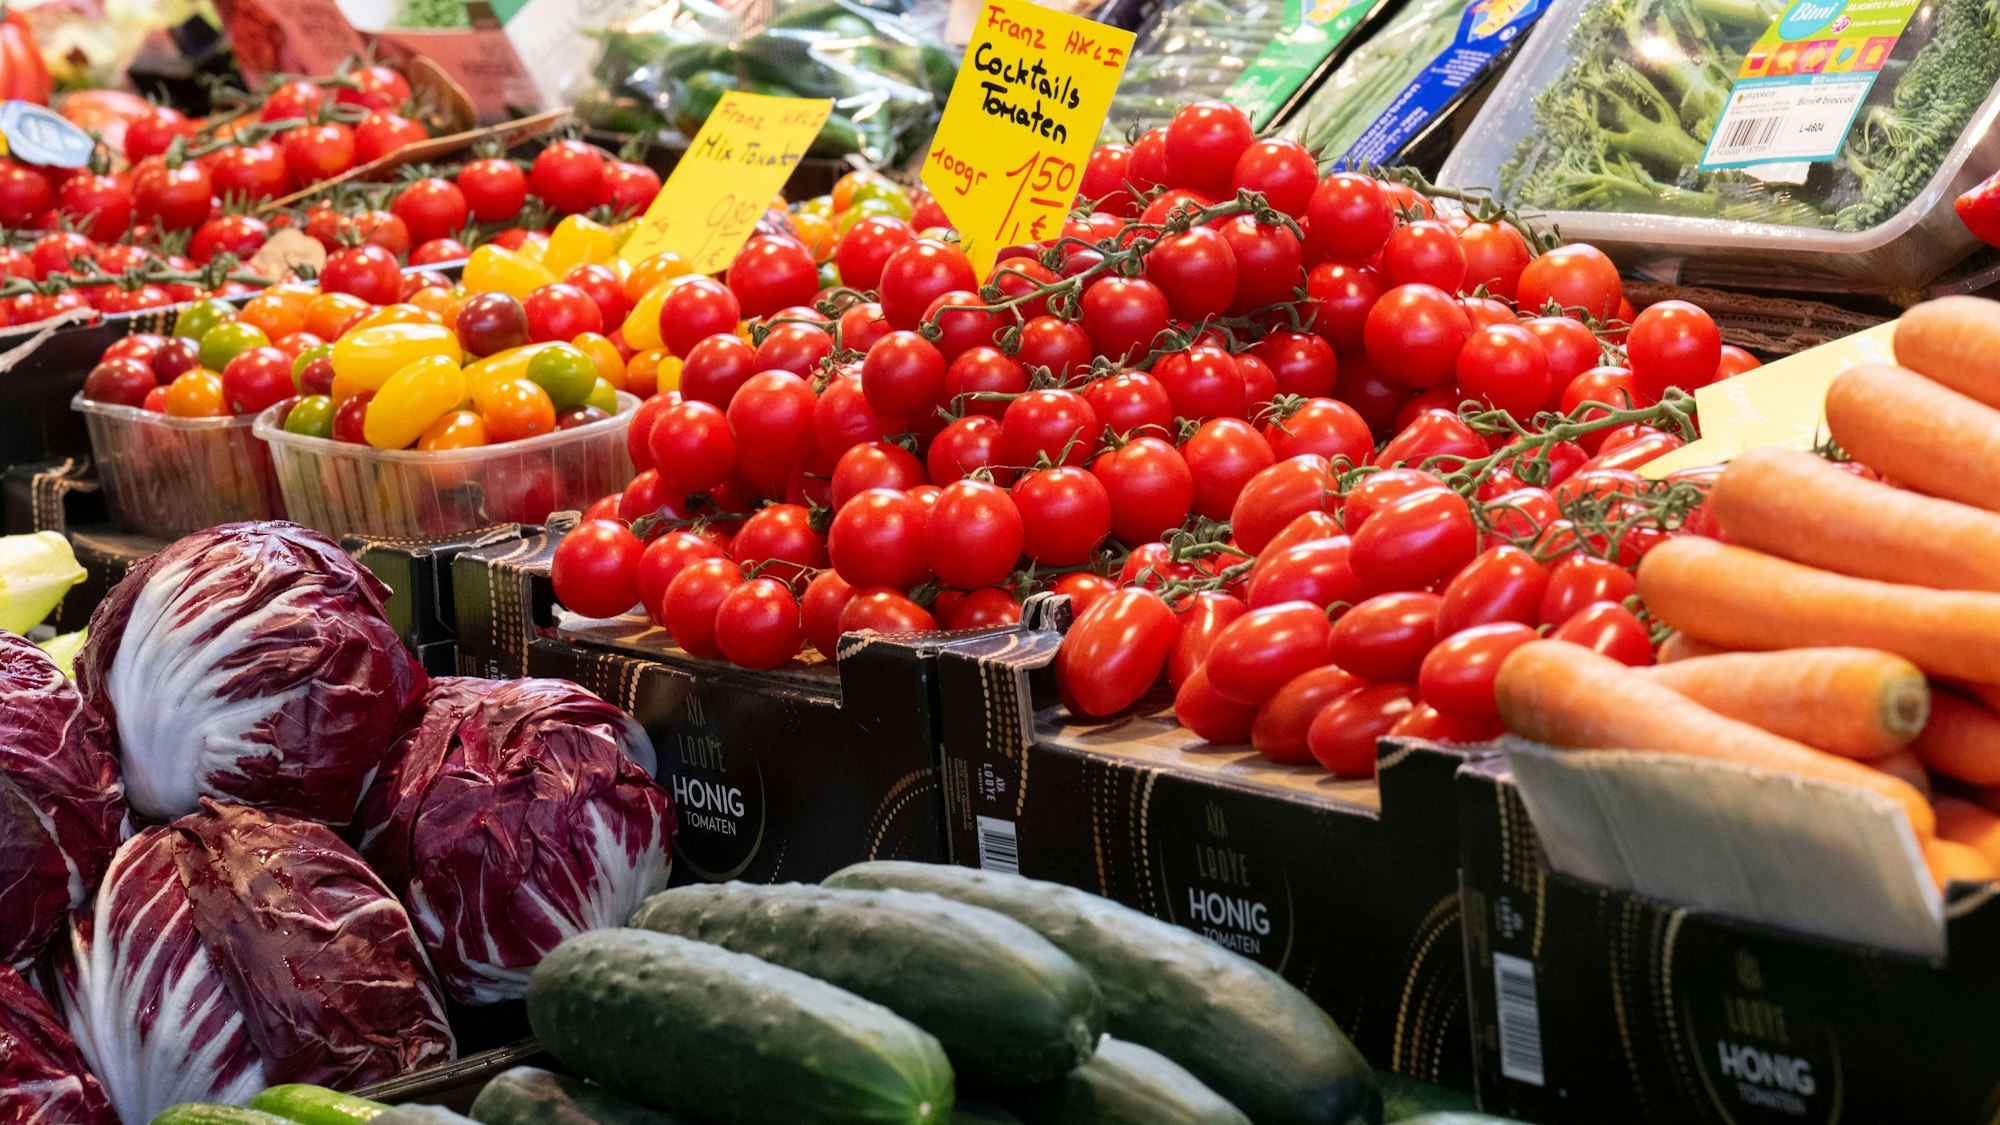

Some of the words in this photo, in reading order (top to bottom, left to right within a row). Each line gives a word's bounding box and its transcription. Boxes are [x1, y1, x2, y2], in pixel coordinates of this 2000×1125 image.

[1789, 2, 1838, 22] Bimi
[1846, 1, 1888, 12] SLIGHTLY
[988, 5, 1046, 49] Franz
[974, 42, 1080, 109] Cocktails
[721, 102, 764, 130] Franz
[981, 81, 1066, 144] Tomaten
[1822, 95, 1855, 105] broccoli
[695, 133, 733, 162] Mix
[932, 147, 987, 196] 100gr
[1030, 215, 1047, 241] €
[678, 733, 726, 773] LOOYE
[672, 774, 745, 817] HONIG
[984, 763, 996, 802] LOOYE
[685, 811, 737, 836] TOMATEN
[1188, 887, 1271, 936] HONIG
[1717, 1039, 1817, 1096] HONIG
